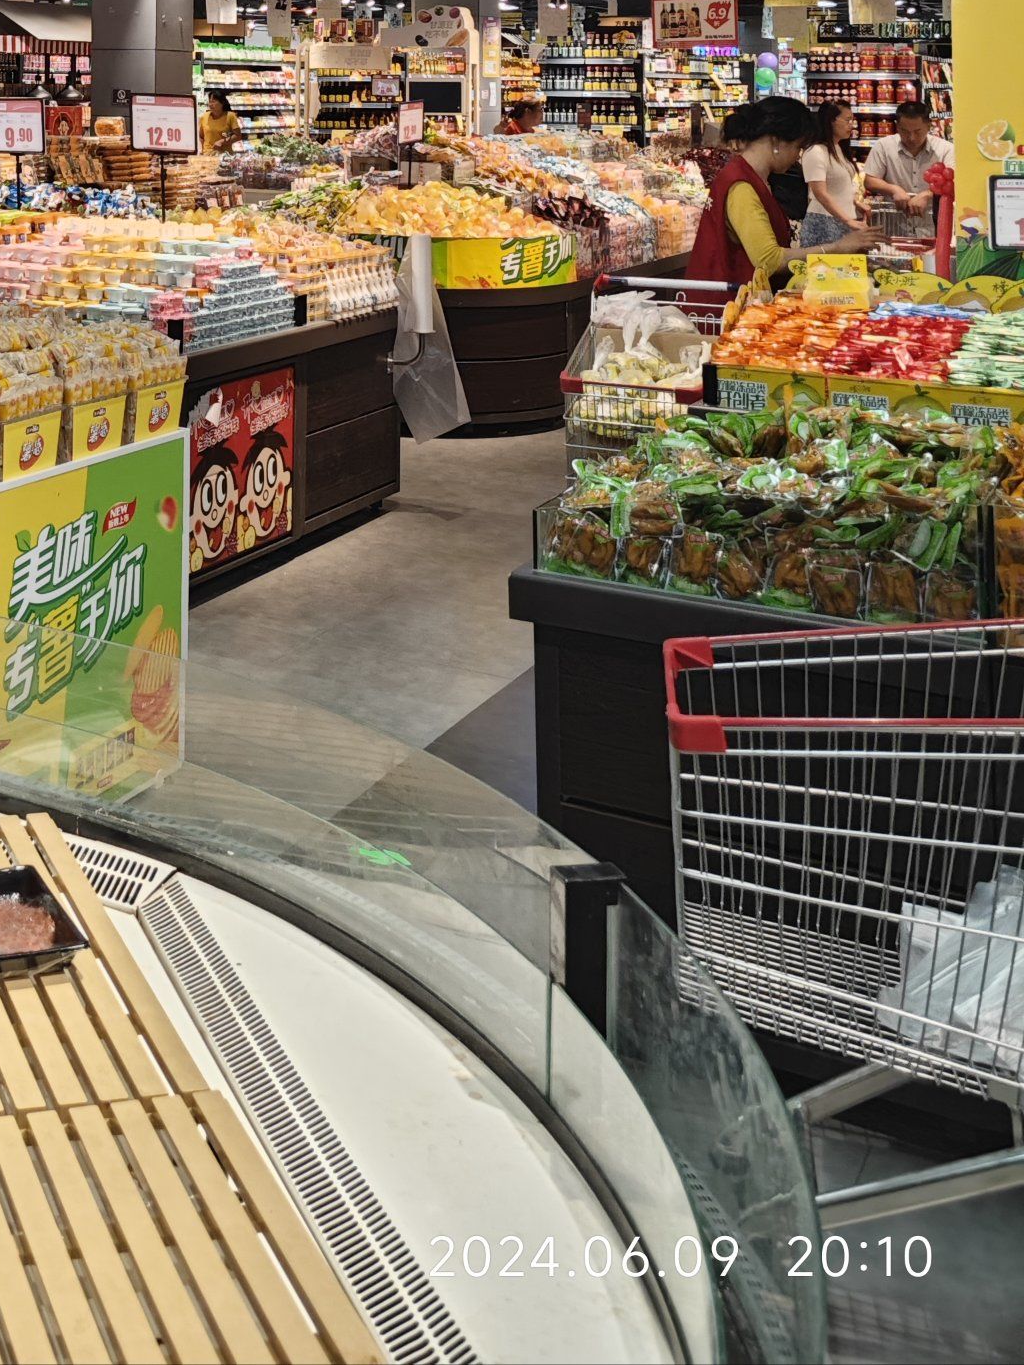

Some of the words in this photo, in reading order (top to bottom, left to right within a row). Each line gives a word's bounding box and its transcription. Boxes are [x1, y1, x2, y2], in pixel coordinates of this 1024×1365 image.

[708, 8, 727, 19] 6.9
[5, 127, 33, 148] 9.90
[147, 127, 181, 146] 12.90
[109, 504, 129, 519] NEW
[6, 511, 95, 634] 美味
